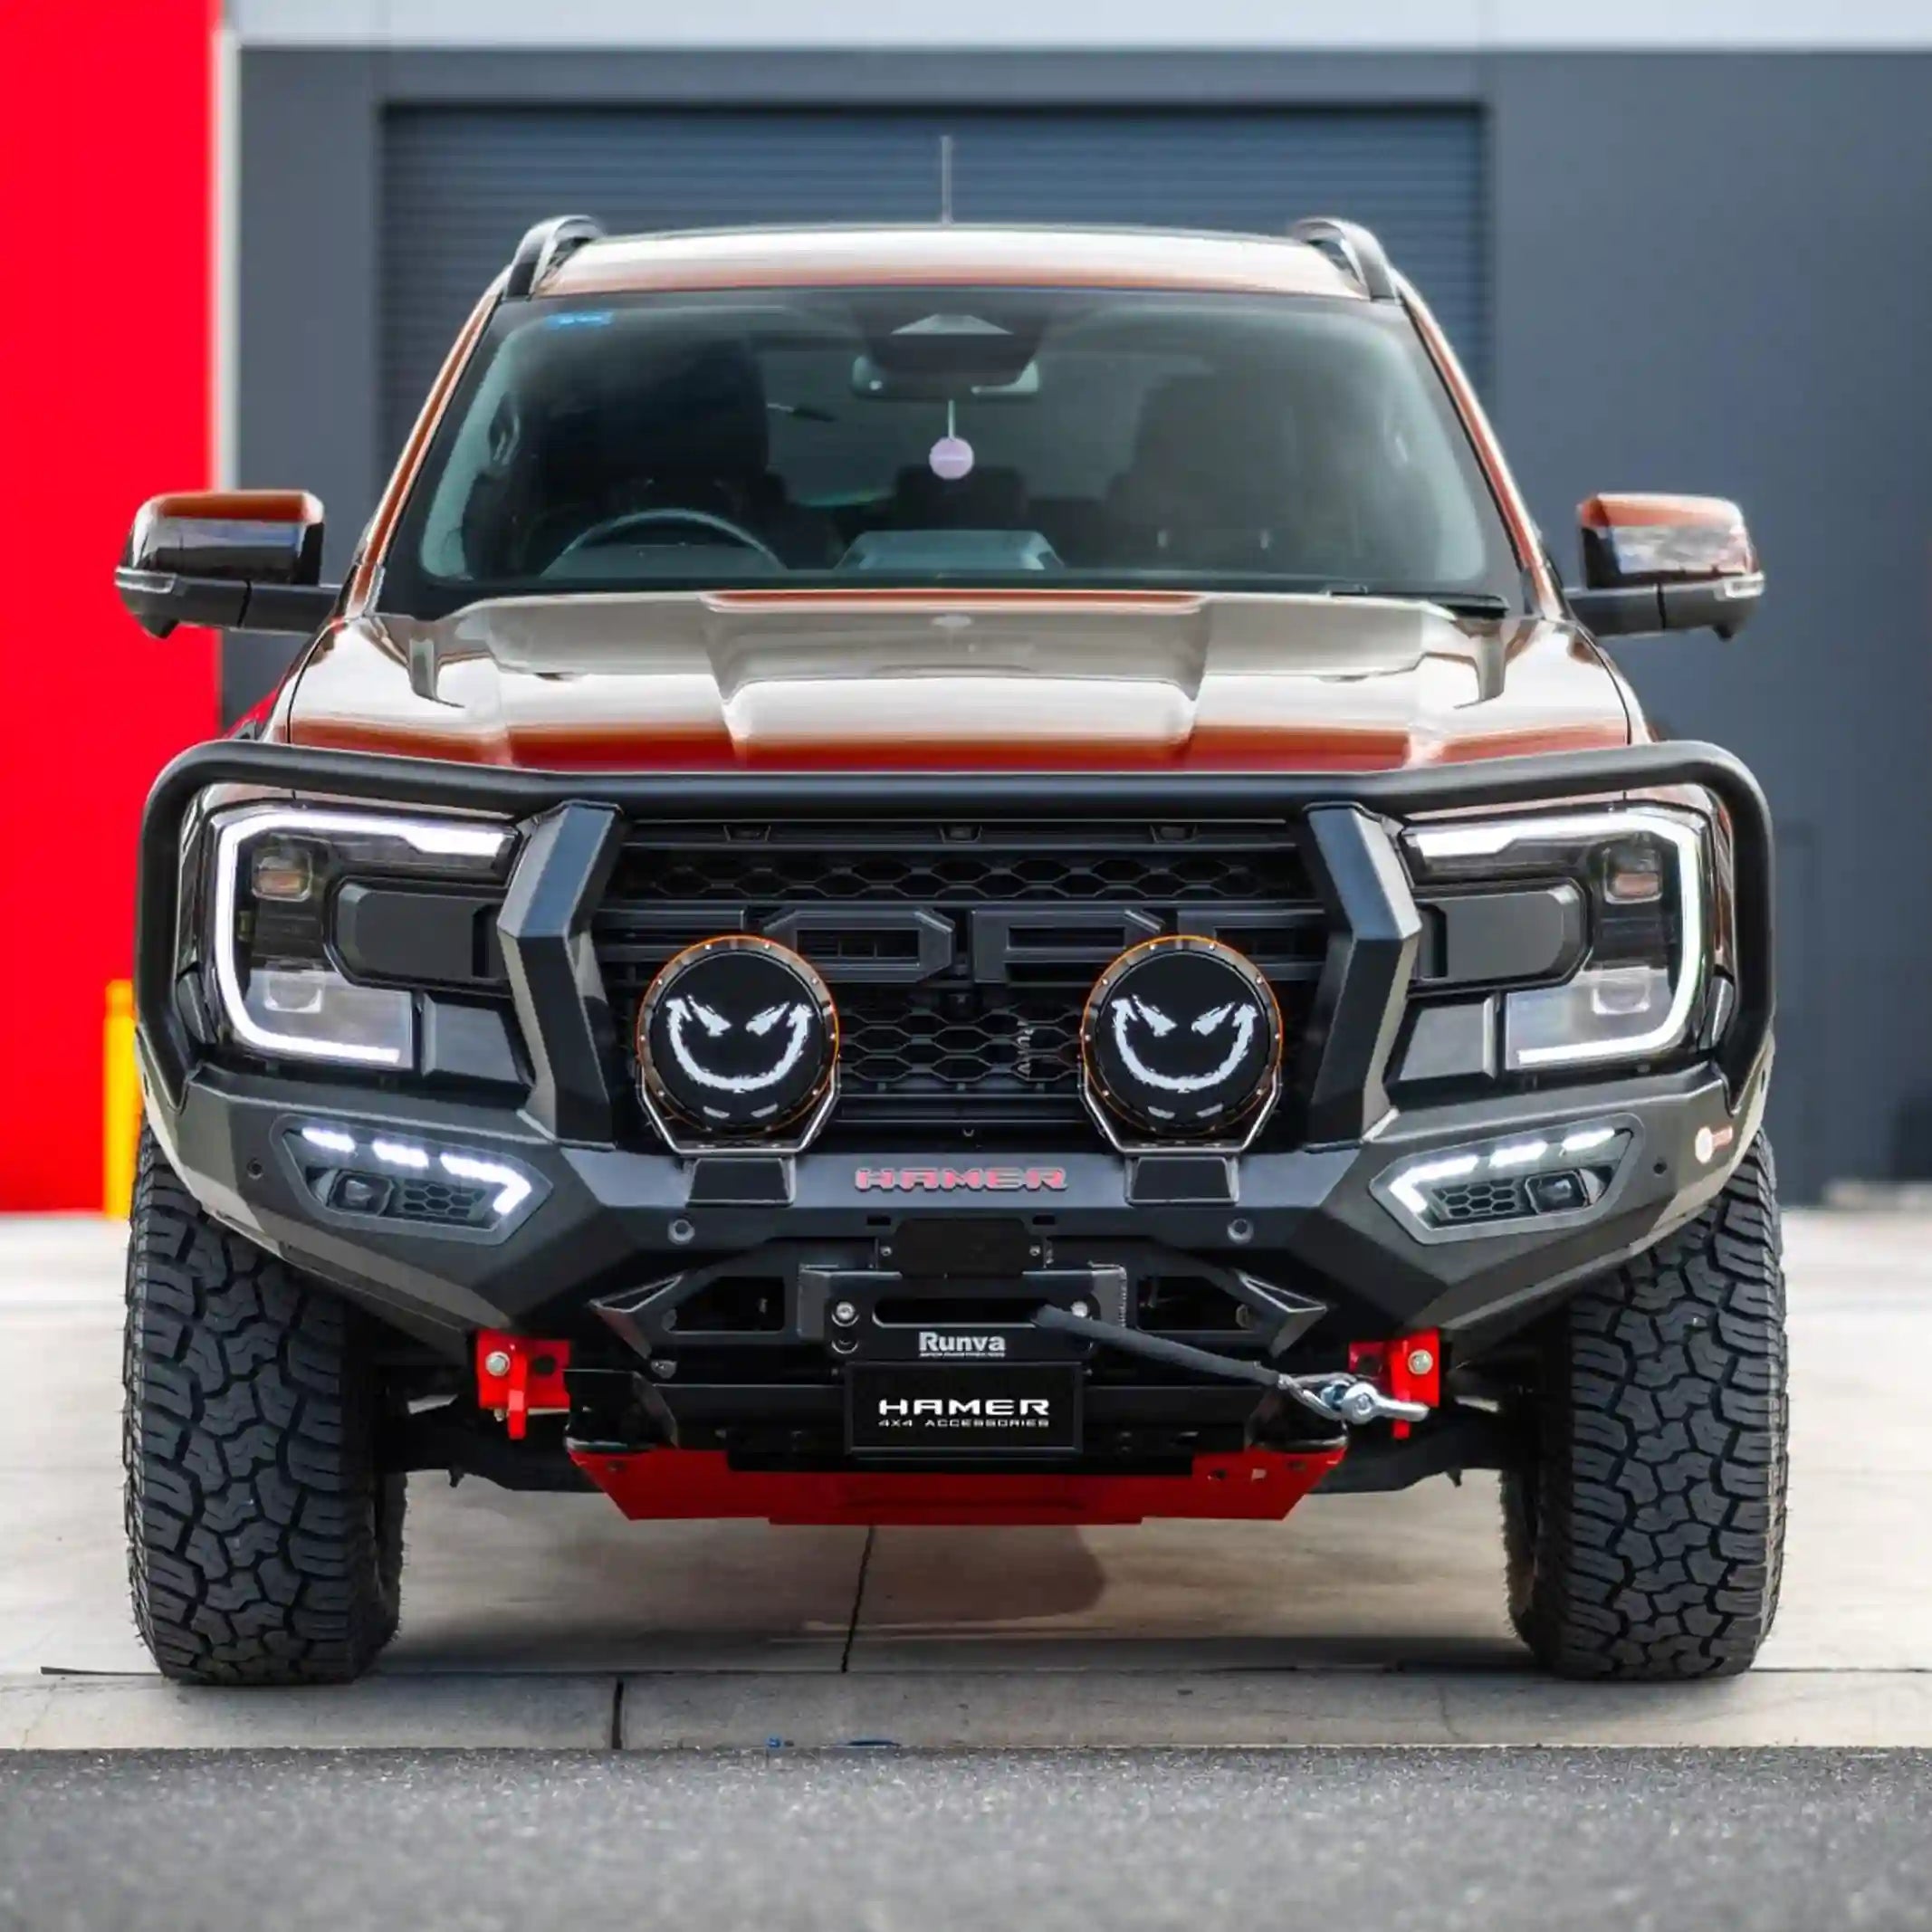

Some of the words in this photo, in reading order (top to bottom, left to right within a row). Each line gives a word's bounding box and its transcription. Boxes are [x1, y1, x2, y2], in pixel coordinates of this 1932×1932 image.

[855, 1167, 1067, 1191] HAMER
[918, 1332, 1007, 1352] Runva
[878, 1399, 1050, 1416] HAMER
[924, 1419, 1050, 1428] ACCESSORIES
